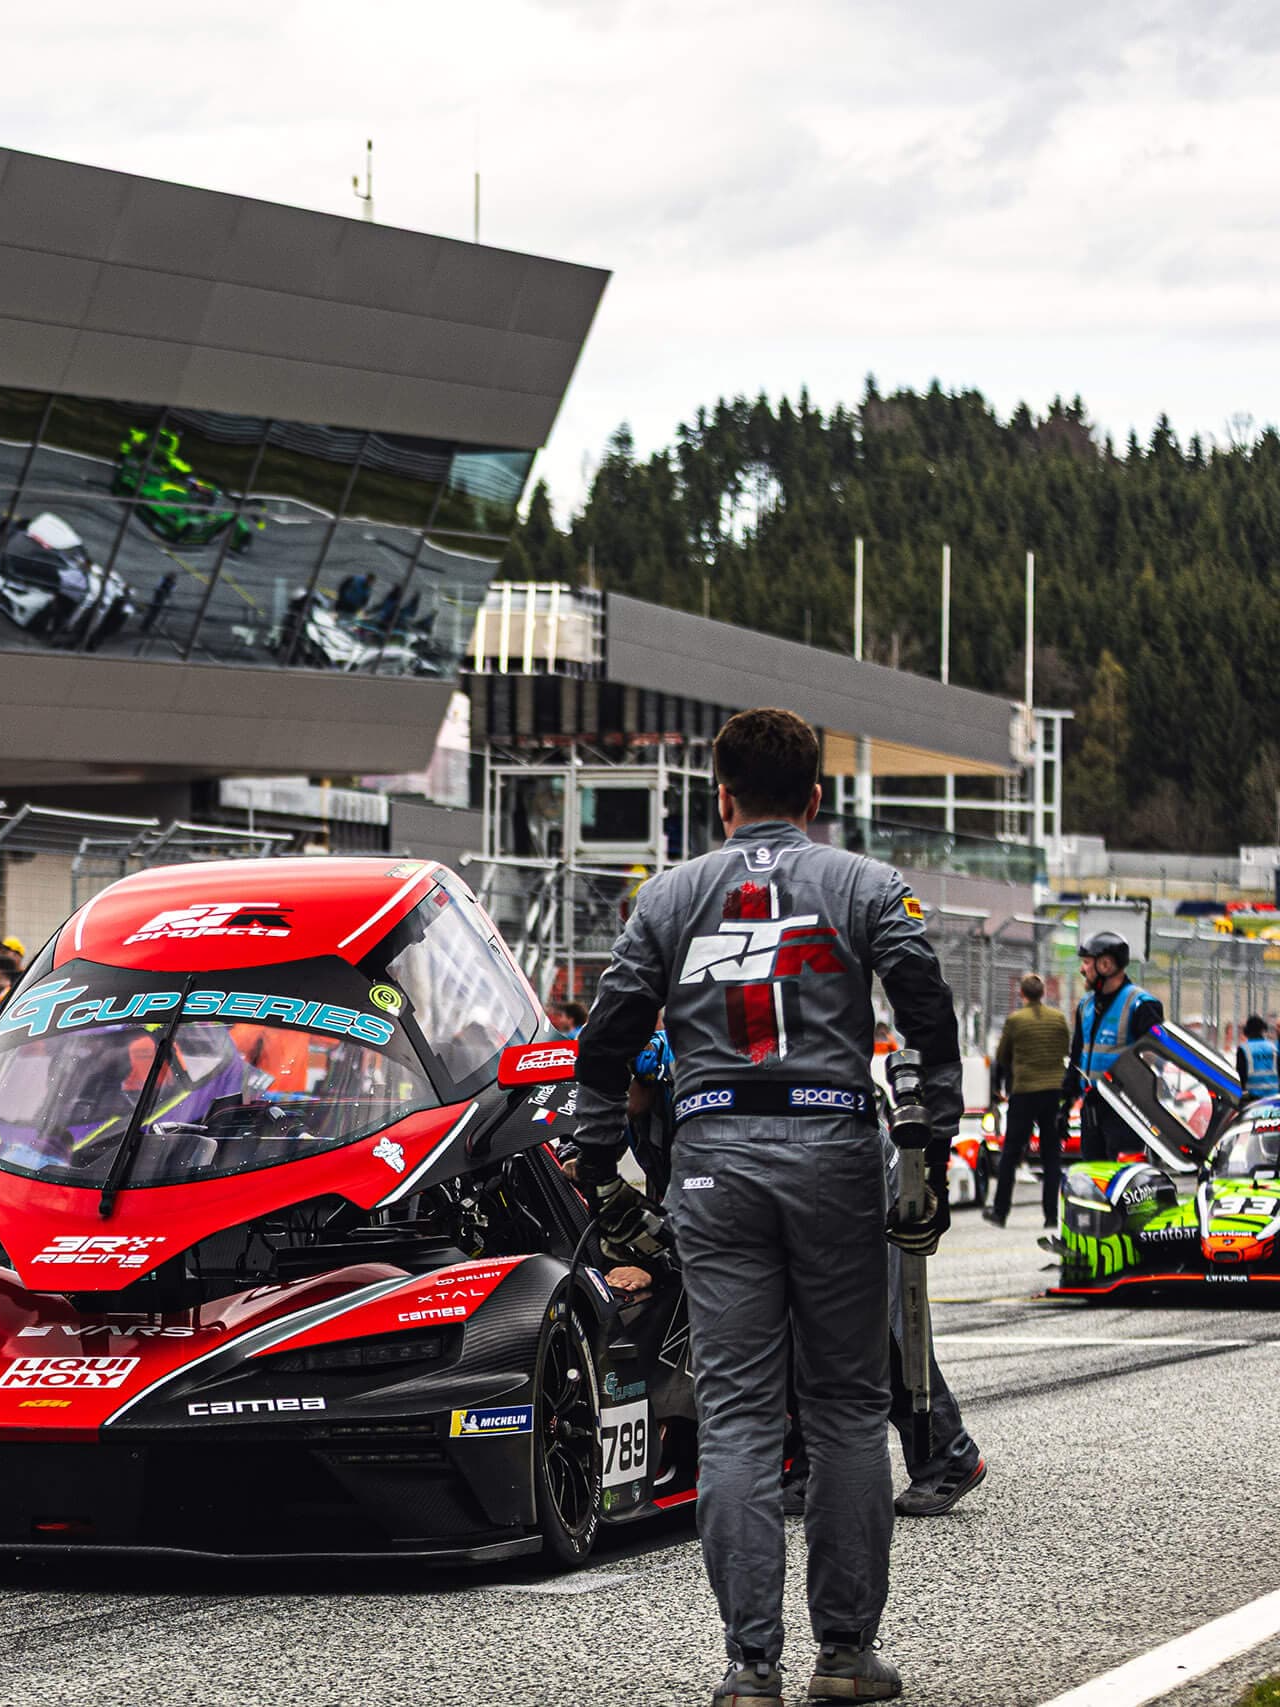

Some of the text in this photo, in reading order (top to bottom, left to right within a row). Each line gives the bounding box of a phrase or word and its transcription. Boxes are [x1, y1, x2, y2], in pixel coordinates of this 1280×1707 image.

[122, 926, 291, 946] projects
[398, 1306, 467, 1322] camea
[15, 1358, 135, 1372] LIQUI
[3, 1373, 126, 1387] MOLY
[188, 1397, 326, 1416] camea
[480, 1414, 527, 1428] MICHELIN
[601, 1419, 646, 1475] 789
